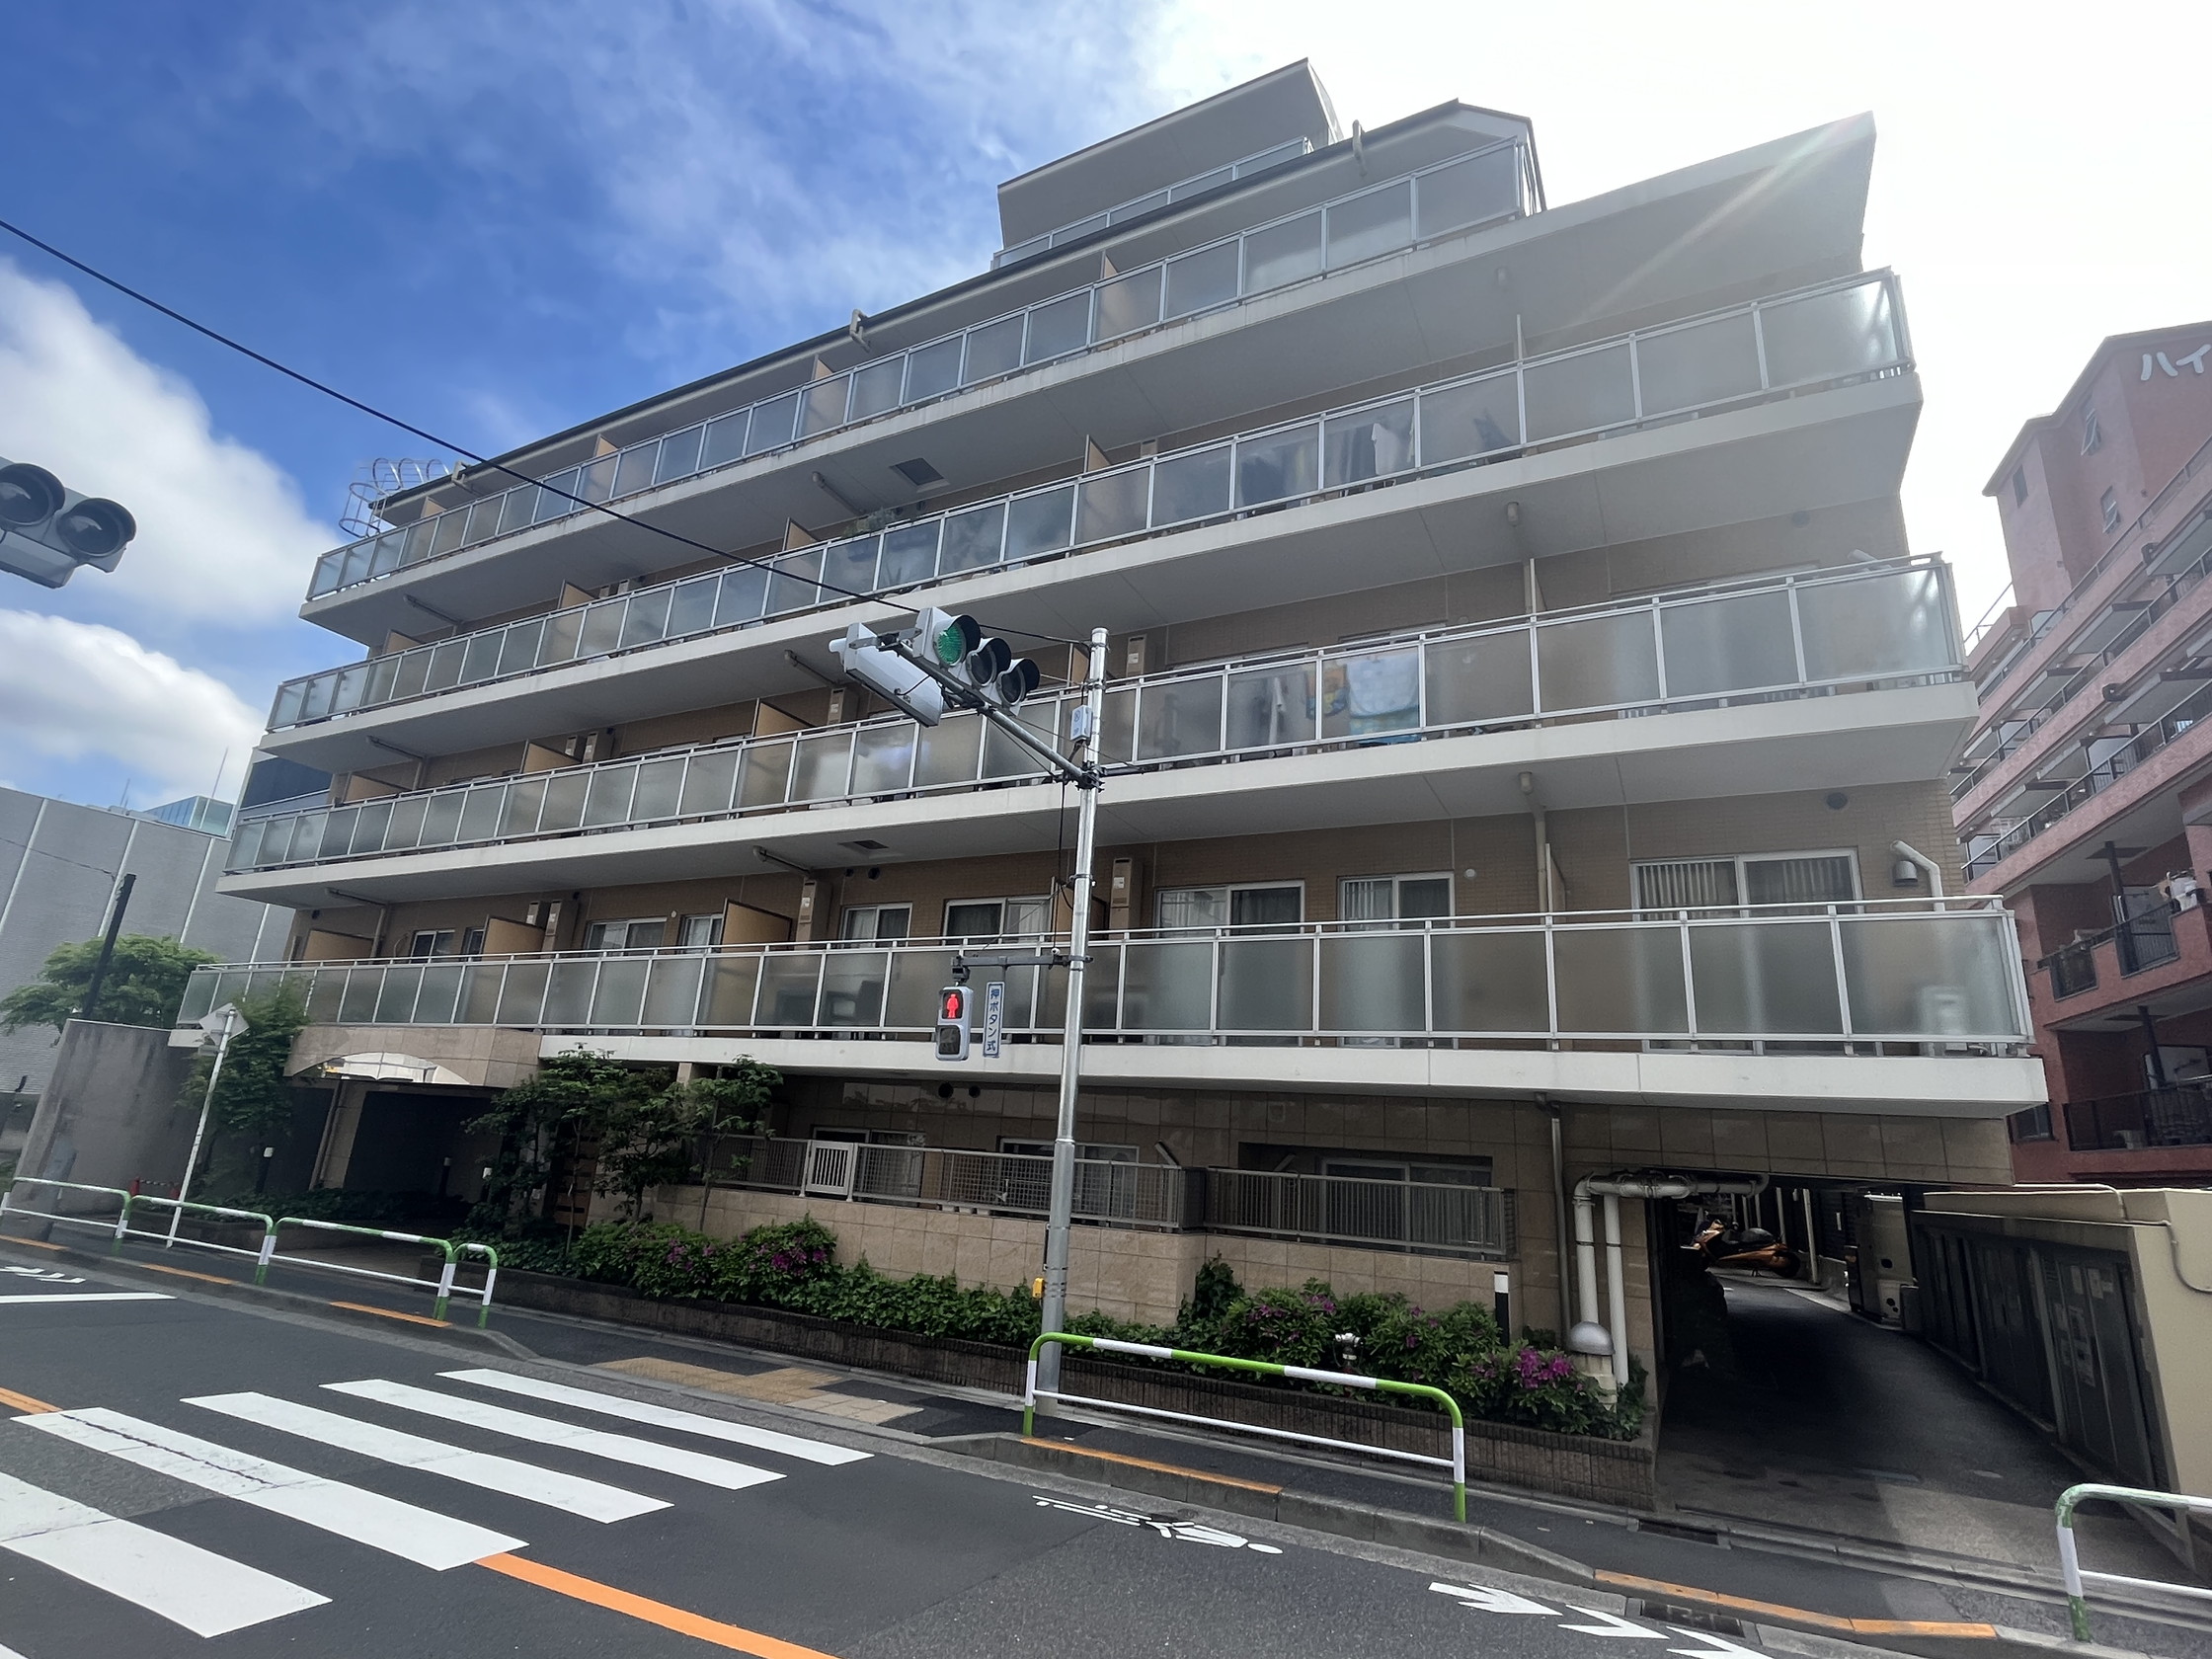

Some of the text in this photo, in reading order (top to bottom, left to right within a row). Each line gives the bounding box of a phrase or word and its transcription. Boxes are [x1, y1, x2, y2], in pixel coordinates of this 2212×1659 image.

[987, 988, 1000, 1052] 押ボタン式
